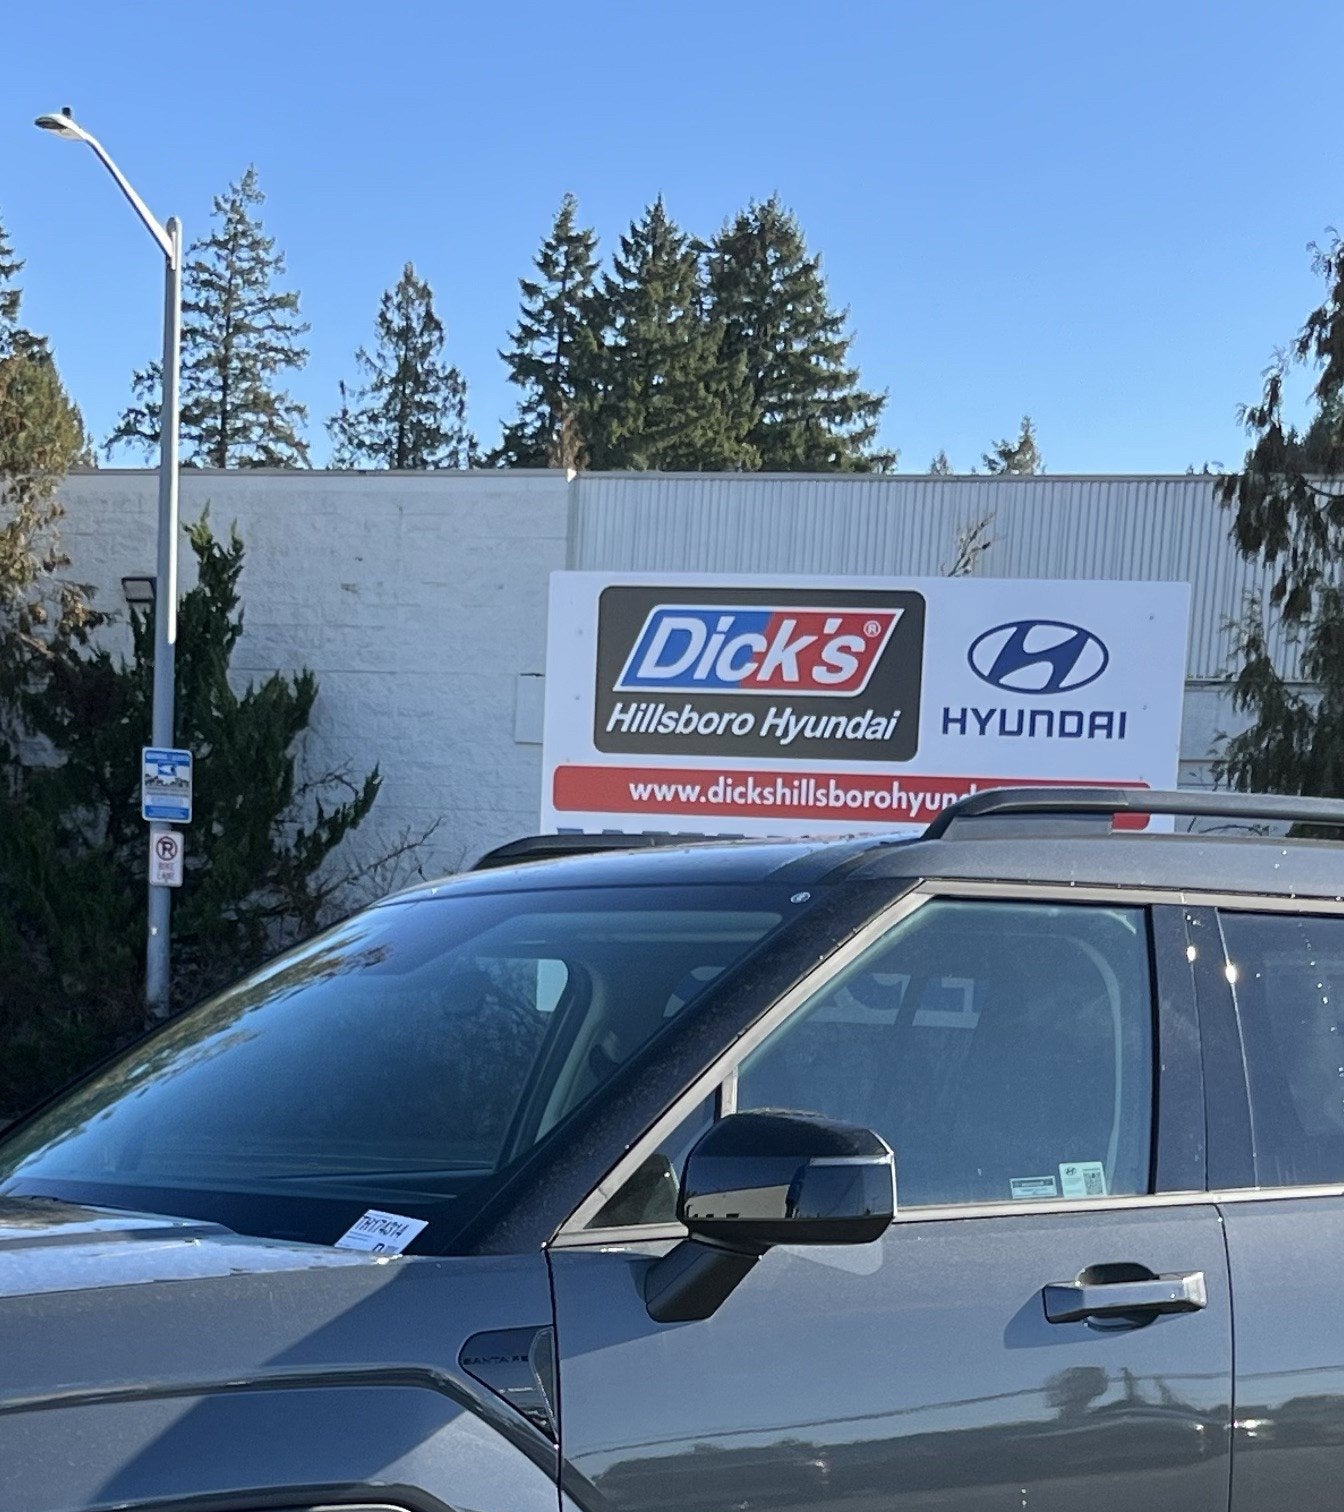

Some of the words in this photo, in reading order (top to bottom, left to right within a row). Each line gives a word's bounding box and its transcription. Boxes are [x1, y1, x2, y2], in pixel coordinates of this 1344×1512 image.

[636, 615, 866, 684] Dick's
[606, 703, 754, 734] Hillsboro
[759, 707, 902, 745] Hyundai
[942, 706, 1127, 740] HYUNDAI
